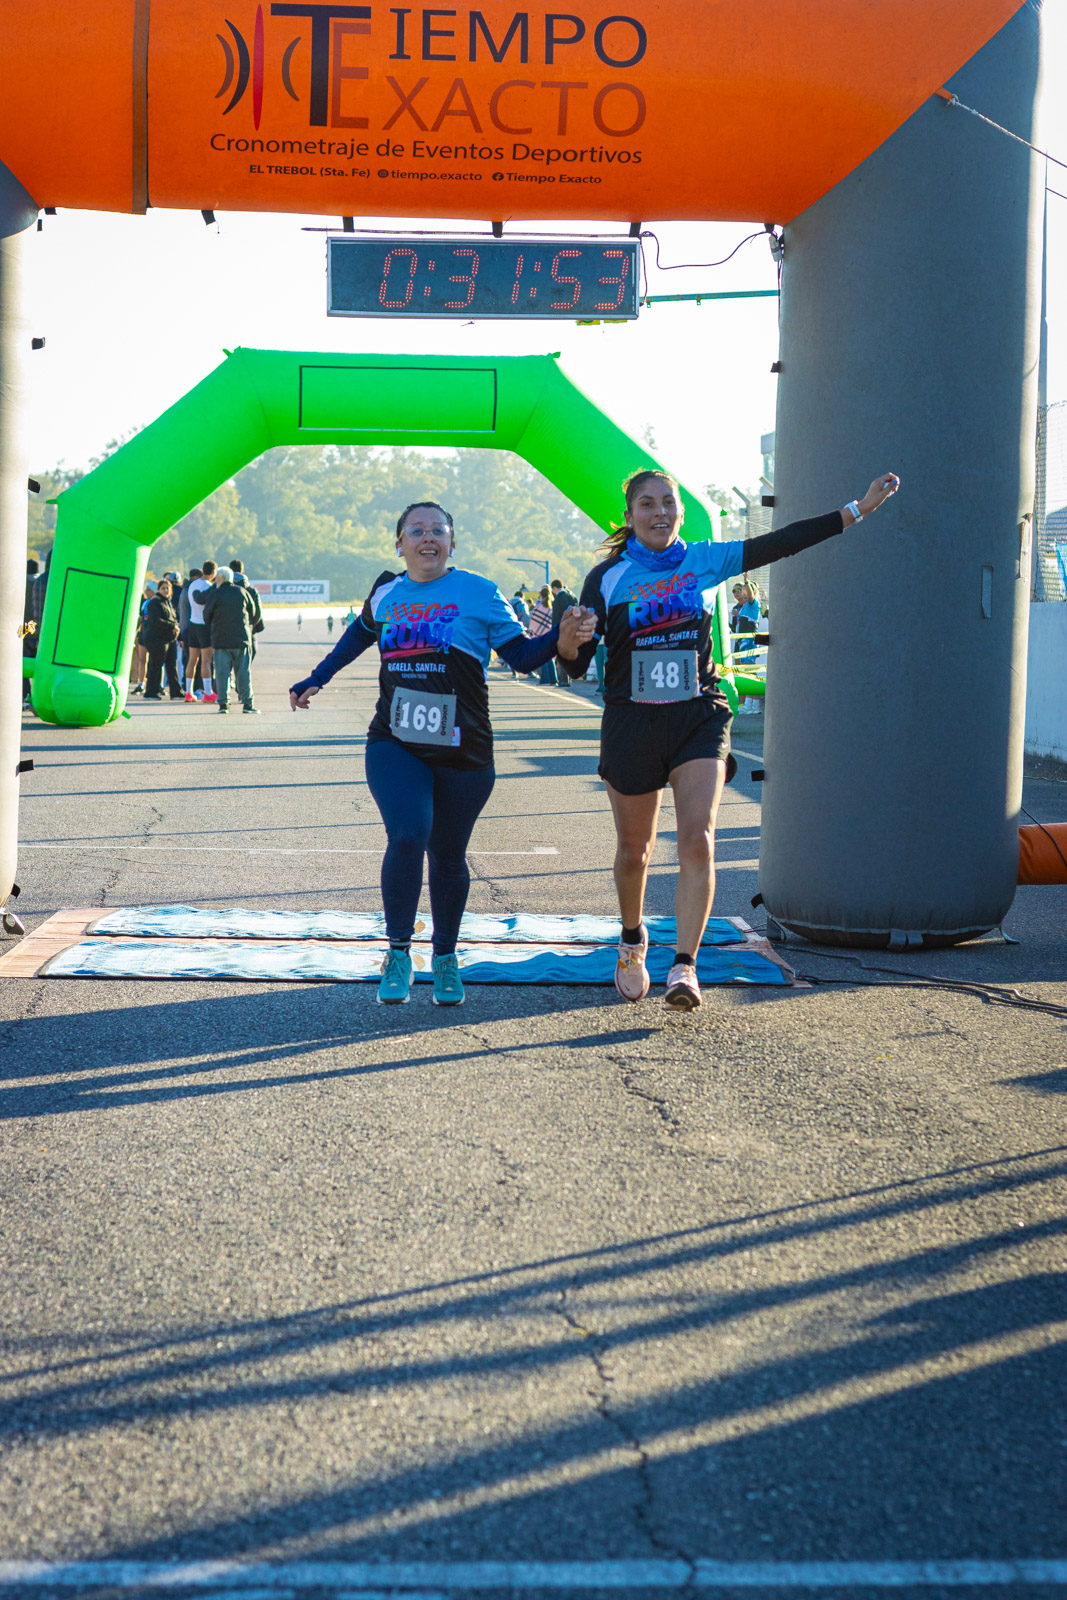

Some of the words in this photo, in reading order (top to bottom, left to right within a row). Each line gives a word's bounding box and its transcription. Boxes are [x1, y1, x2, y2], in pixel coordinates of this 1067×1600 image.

[210, 133, 369, 159] Cronometraje
[376, 139, 405, 157] de
[412, 140, 504, 160] Eventos
[512, 143, 642, 165] Deportivos
[249, 165, 264, 174] EL
[266, 165, 317, 176] TREBOL
[320, 167, 349, 178] (Sta.
[351, 168, 370, 179] Fe)
[391, 170, 482, 182] tiempo.exacto
[506, 173, 556, 185] Tiempo
[559, 174, 602, 184] Exacto
[275, 585, 320, 593] LONG
[650, 661, 680, 688] 48
[400, 701, 442, 733] 169
